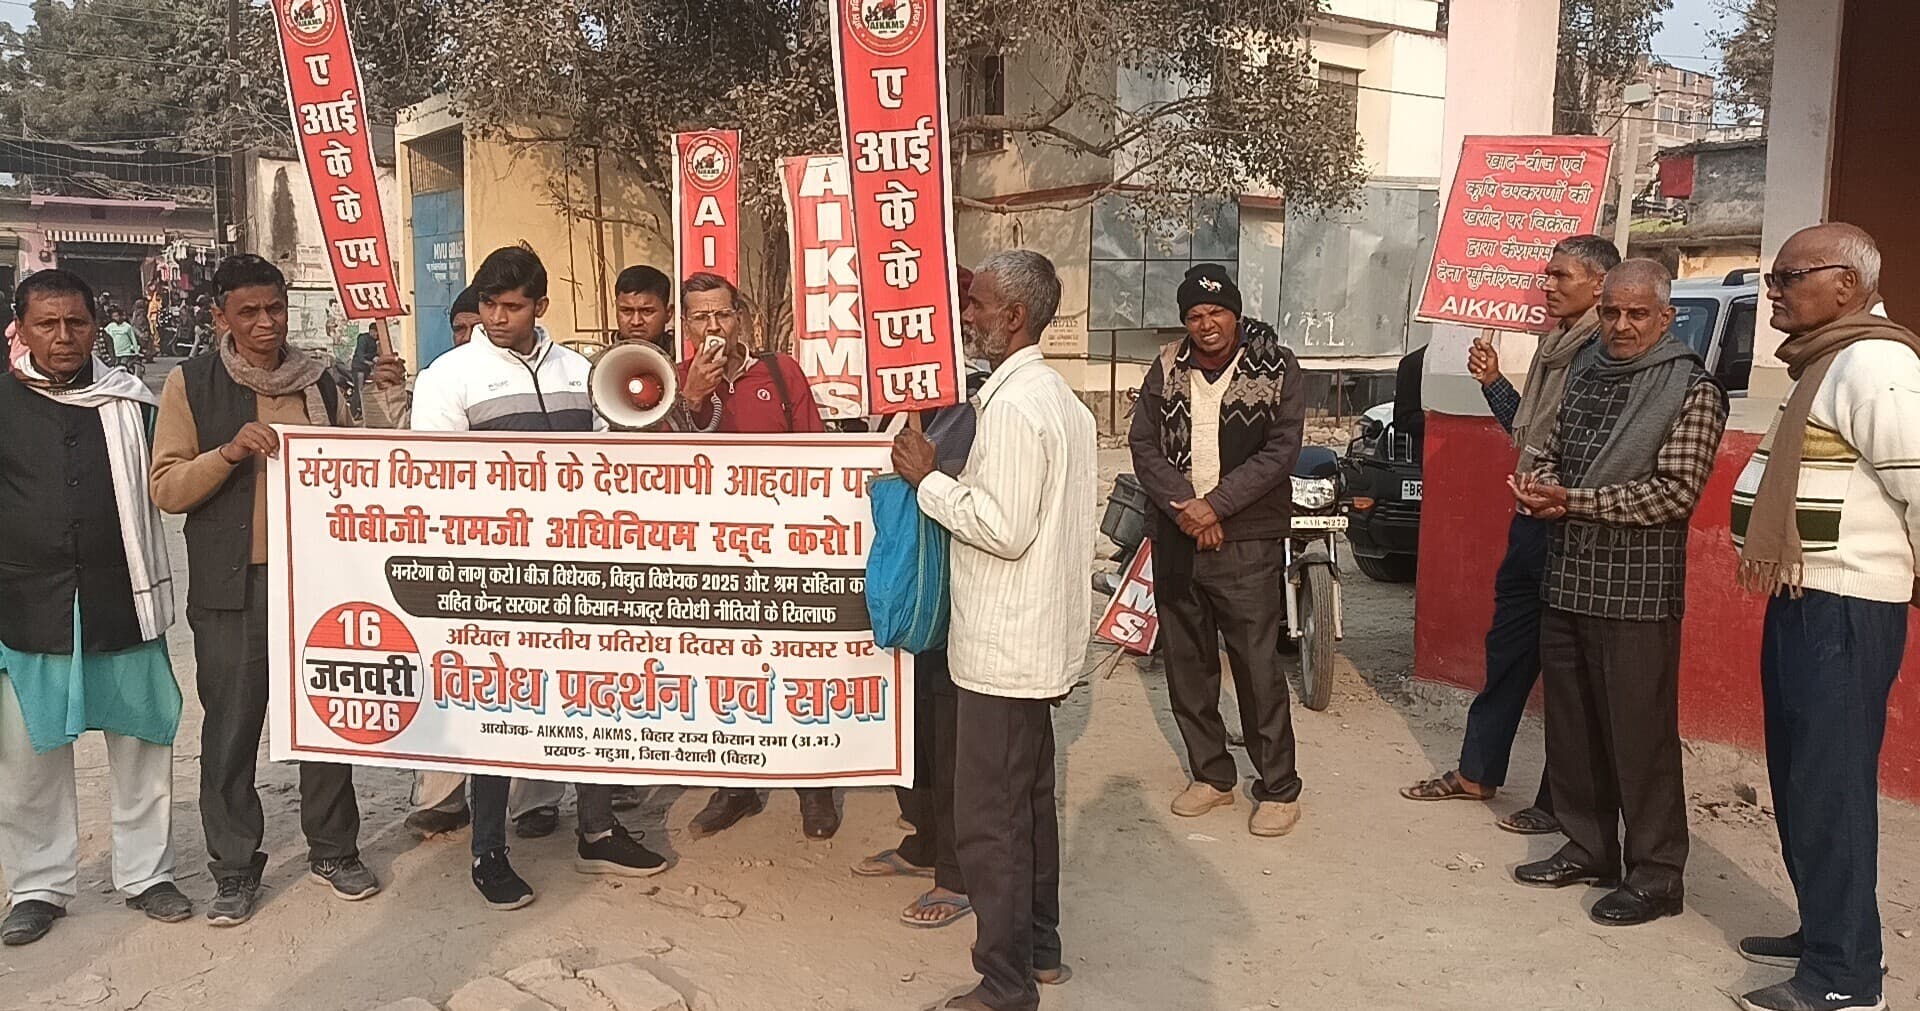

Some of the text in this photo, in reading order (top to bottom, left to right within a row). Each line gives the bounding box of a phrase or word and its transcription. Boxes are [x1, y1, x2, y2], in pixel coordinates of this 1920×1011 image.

[869, 20, 905, 30] AIKKMS
[870, 66, 908, 109] ए
[854, 115, 935, 175] आई
[300, 54, 391, 311] ए आई के के एम एस
[1559, 151, 1587, 177] एवं
[874, 179, 918, 231] के
[1501, 181, 1566, 203] उपकरणों
[1569, 181, 1594, 204] की
[1464, 205, 1580, 233] खरीद पर विक्रेता
[878, 239, 921, 289] के
[1466, 238, 1498, 259] द्वारा
[799, 156, 863, 420] AIKKMS
[1437, 259, 1463, 282] देना
[872, 306, 936, 348] एम
[1440, 295, 1549, 324] AIKKMS
[876, 362, 941, 403] एस
[297, 447, 380, 498] संयुक्त
[388, 448, 477, 490] किसान
[485, 450, 547, 491] मोर्चा
[555, 451, 584, 492] के
[592, 452, 714, 495] देशव्यापी
[724, 465, 832, 505] आह्वान
[326, 504, 862, 563] वीबीजी-रामजी अधिनियम रद्द करो।
[391, 560, 866, 594] मनरेगा को लागू करो। बीज विधेयक, विद्युत विधेयक 2025 और श्रम संहिता क
[437, 589, 837, 624] सहित केन्द्र सरकार की किसान-मजदूर विरोधी नीतियों के खिलाफ
[337, 609, 381, 648] 16
[446, 623, 875, 658] अखिल भारतीय प्रतिरोध दिवस के अवसर पर
[306, 655, 417, 697] जनवरी
[430, 650, 886, 721] विरोध प्रदर्शन एवं सभा
[328, 699, 400, 731] 2026
[537, 725, 588, 741] AIKKMS,
[679, 731, 708, 744] राज्य
[712, 730, 755, 746] किसान
[759, 735, 787, 747] सभा
[639, 746, 716, 763] जिला-वैशाली
